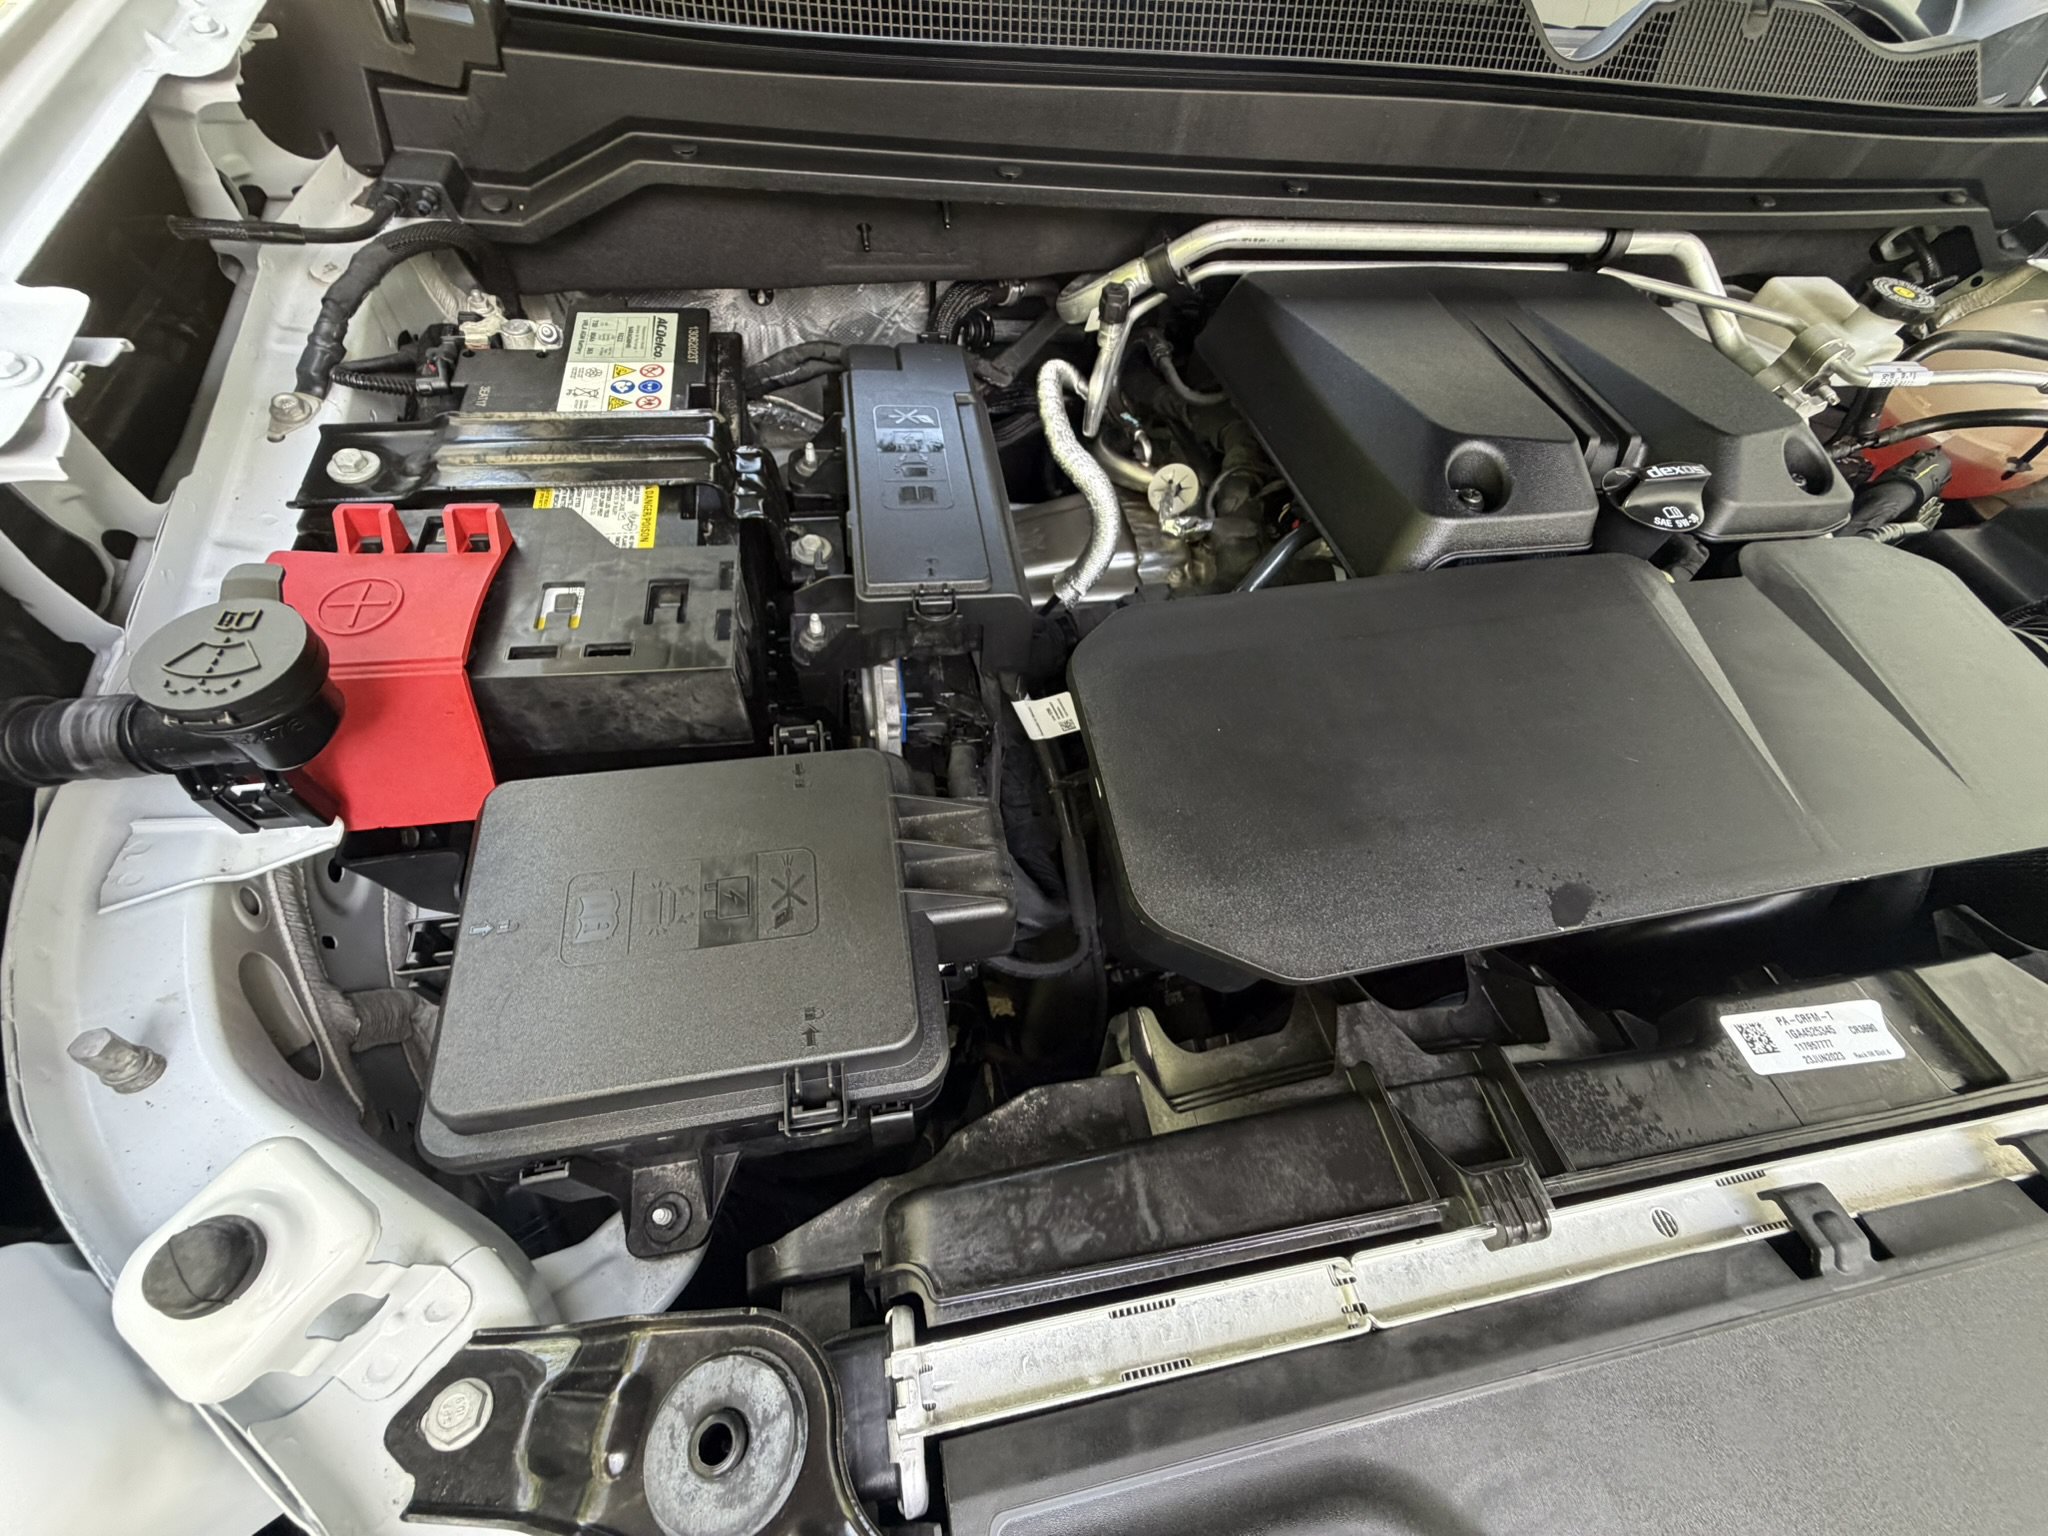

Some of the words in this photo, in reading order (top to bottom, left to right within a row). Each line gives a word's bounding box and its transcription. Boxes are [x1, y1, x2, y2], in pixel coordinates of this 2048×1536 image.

[653, 317, 668, 358] ACDelco
[1646, 465, 1705, 478] dexos
[1653, 516, 1673, 528] SAE
